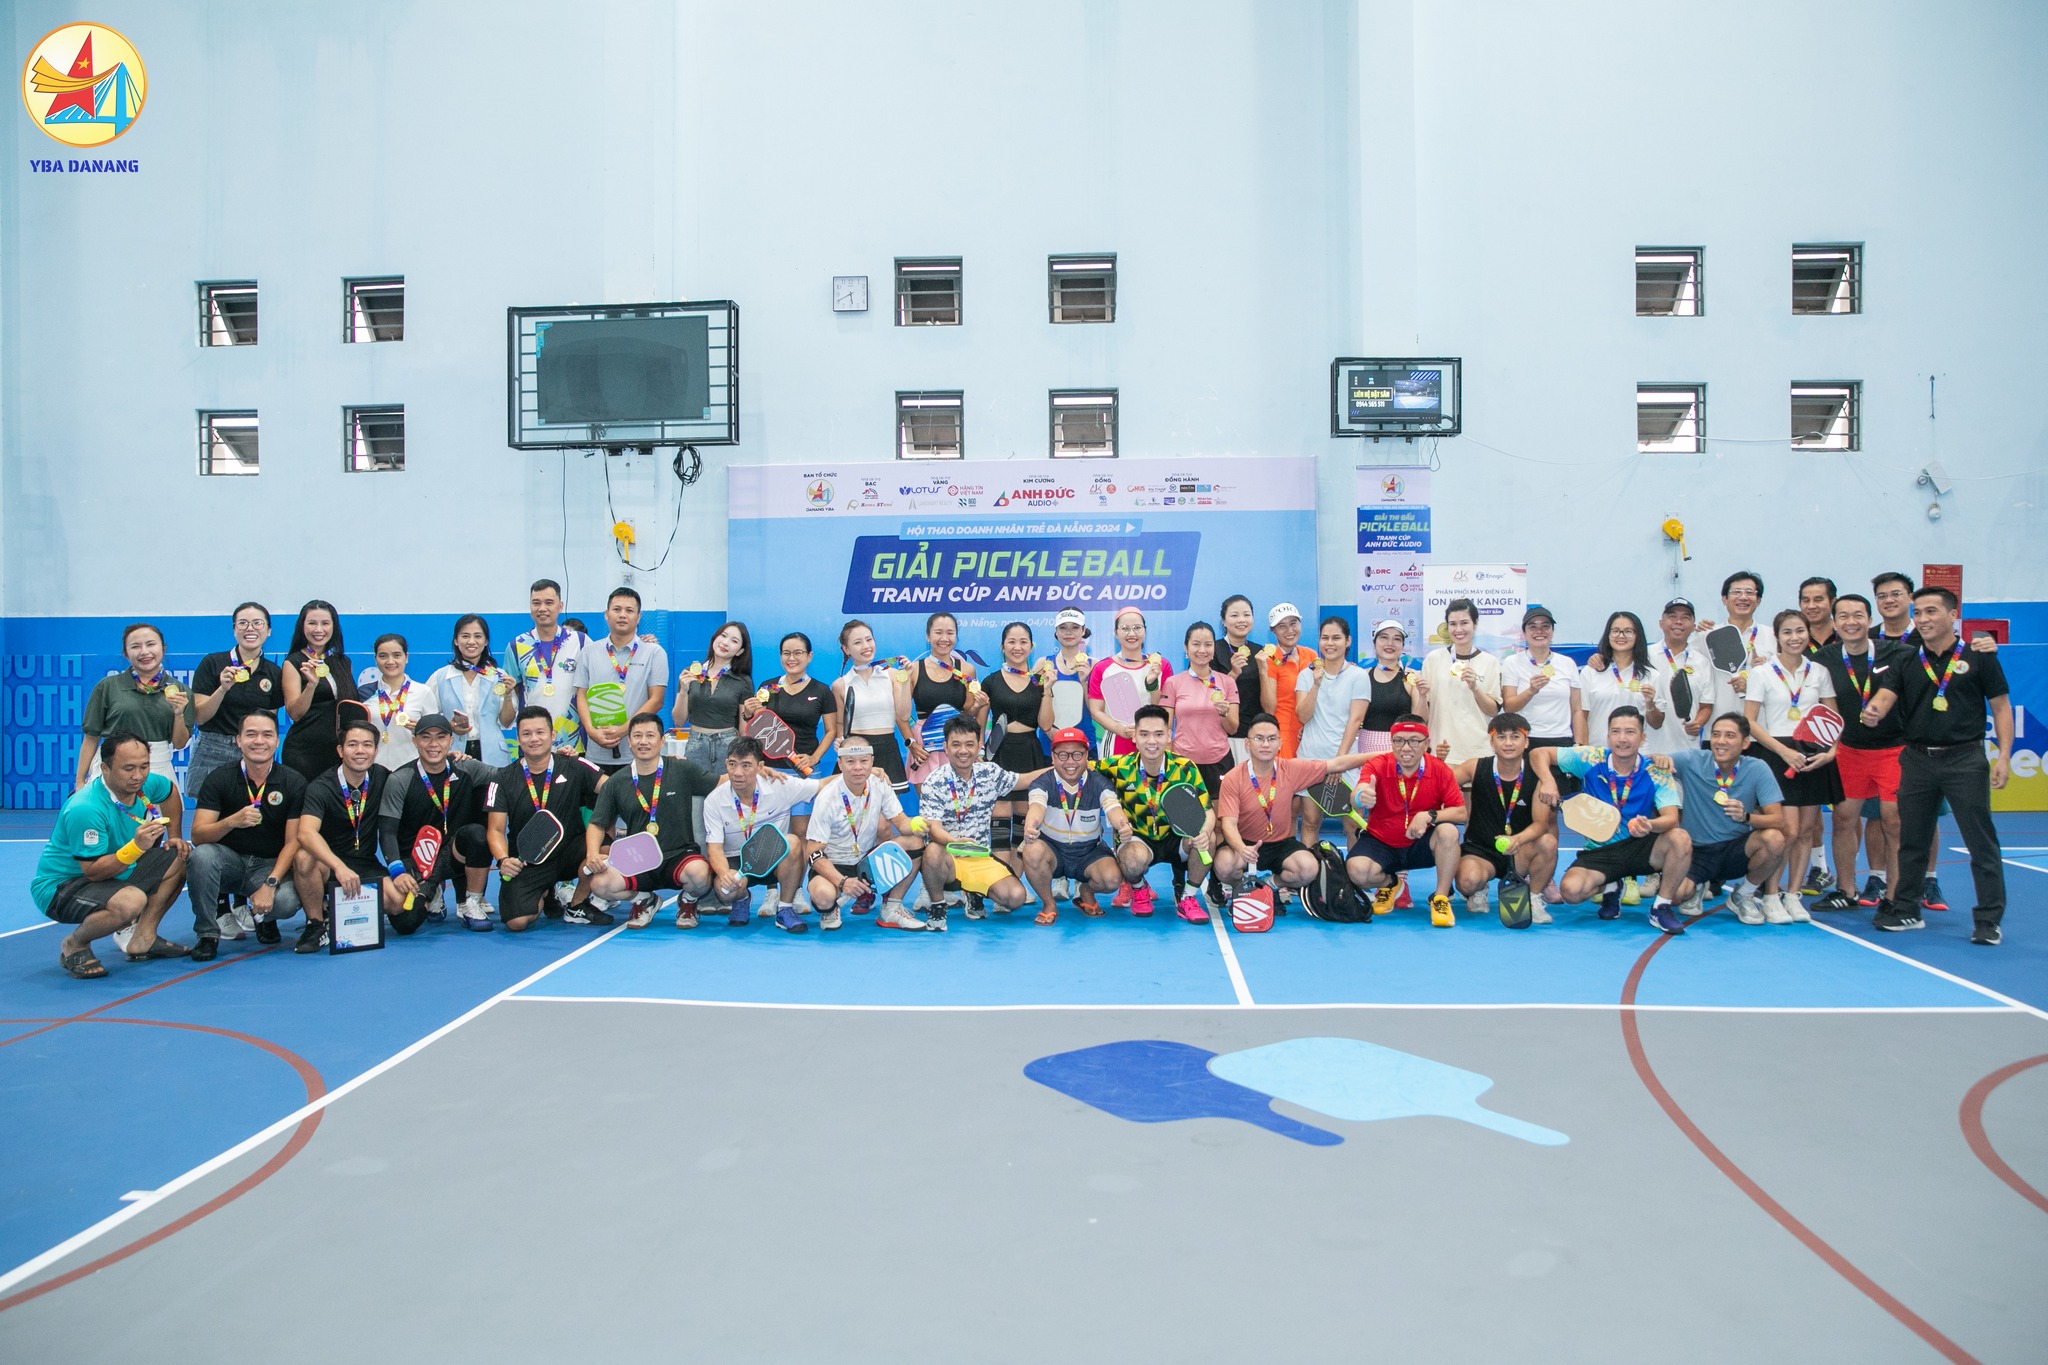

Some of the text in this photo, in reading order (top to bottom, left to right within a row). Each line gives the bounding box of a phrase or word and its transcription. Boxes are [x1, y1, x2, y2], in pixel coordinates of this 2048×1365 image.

[1012, 487, 1075, 499] ANH ĐỨC
[906, 524, 924, 536] HỘI
[927, 526, 954, 535] THAO
[956, 525, 992, 535] DOANH
[994, 523, 1024, 534] NHÂN
[1046, 522, 1062, 533] ĐÀ
[1063, 520, 1094, 533] NẴNG
[1095, 524, 1120, 533] 2024
[1359, 522, 1430, 532] PICKLEBALL
[870, 541, 1172, 580] GIẢI PICKLEBALL
[872, 580, 1167, 603] TRANH CÚP ANH ĐỨC AUDIO
